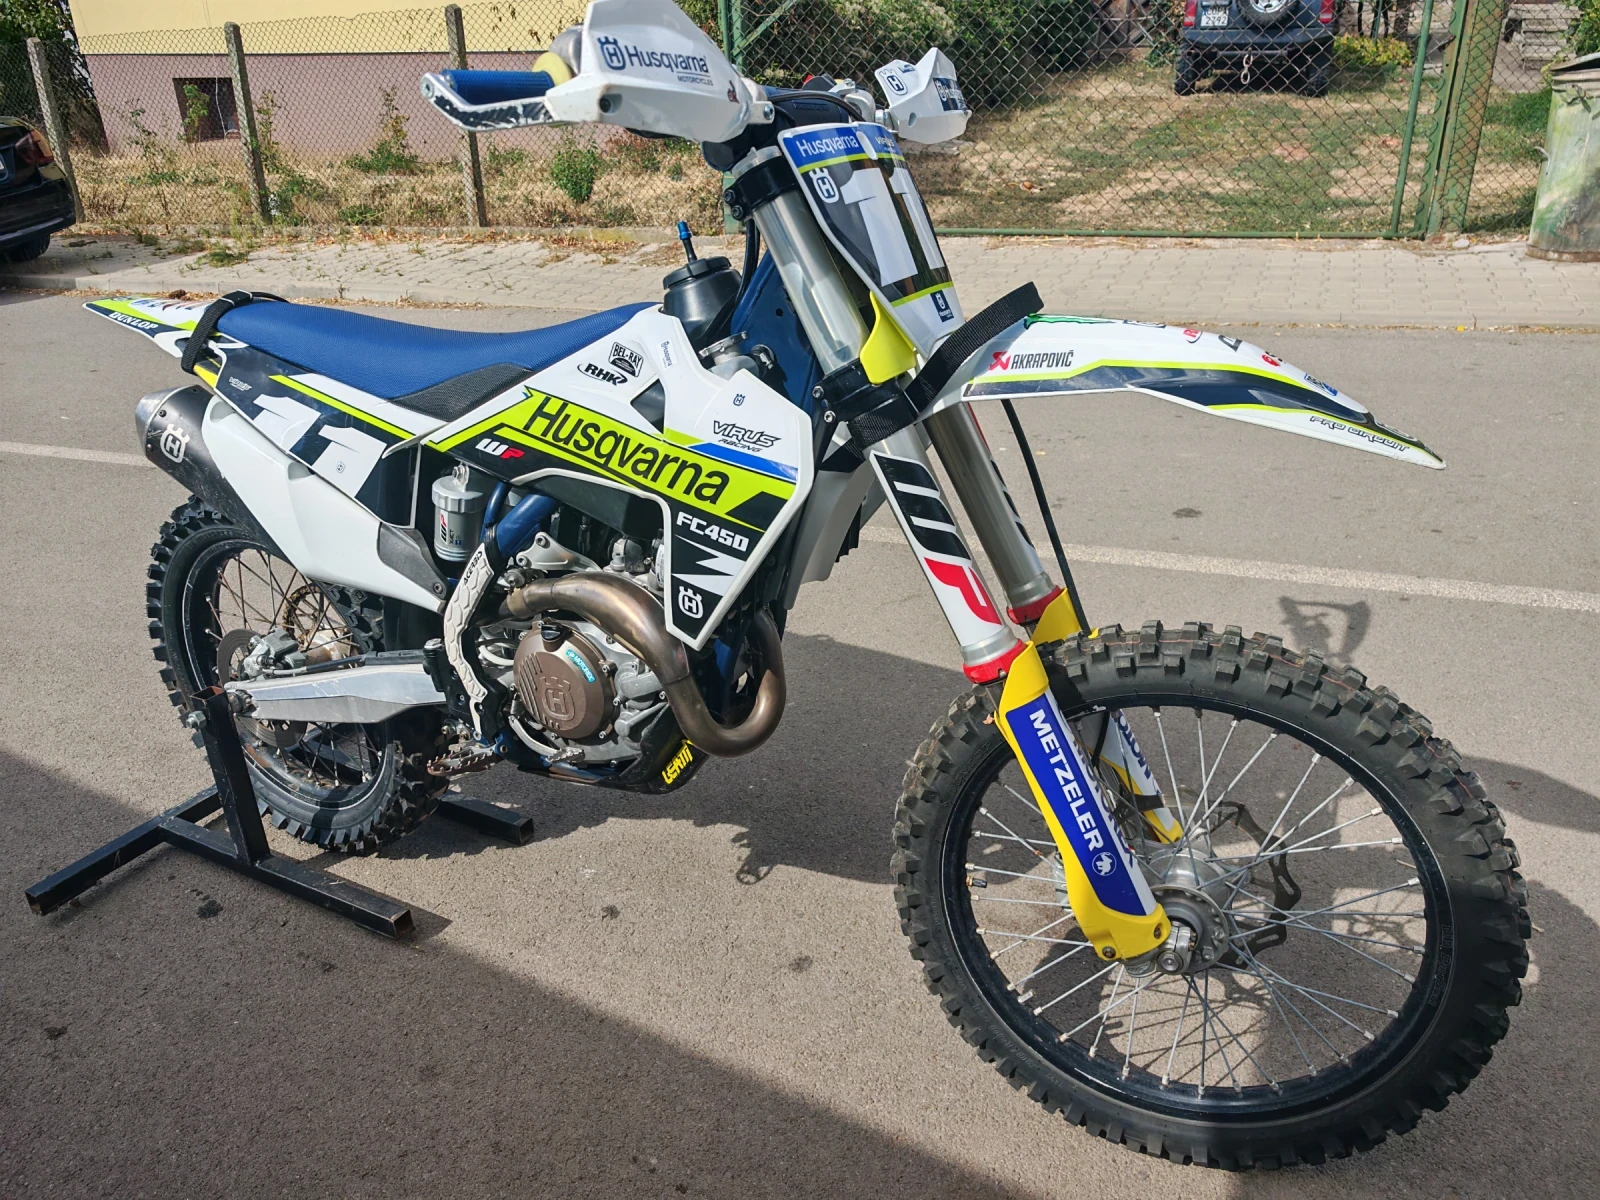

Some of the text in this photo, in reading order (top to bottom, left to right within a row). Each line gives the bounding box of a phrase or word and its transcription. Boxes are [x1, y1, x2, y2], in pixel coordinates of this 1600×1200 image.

[623, 45, 709, 73] Husqvarna
[796, 133, 859, 158] Husqvarna
[109, 311, 159, 330] DUNLOP
[612, 344, 642, 369] BEL-RAY
[1010, 350, 1074, 370] AKRAPOVIČ
[584, 363, 617, 386] RHK
[713, 420, 781, 448] VIRUS
[718, 438, 763, 452] RACING
[1310, 415, 1346, 430] PRO
[1347, 426, 1410, 452] CIRCUIT
[523, 396, 730, 504] Husqvarna
[676, 511, 749, 552] FC450
[1029, 708, 1104, 851] METZELER
